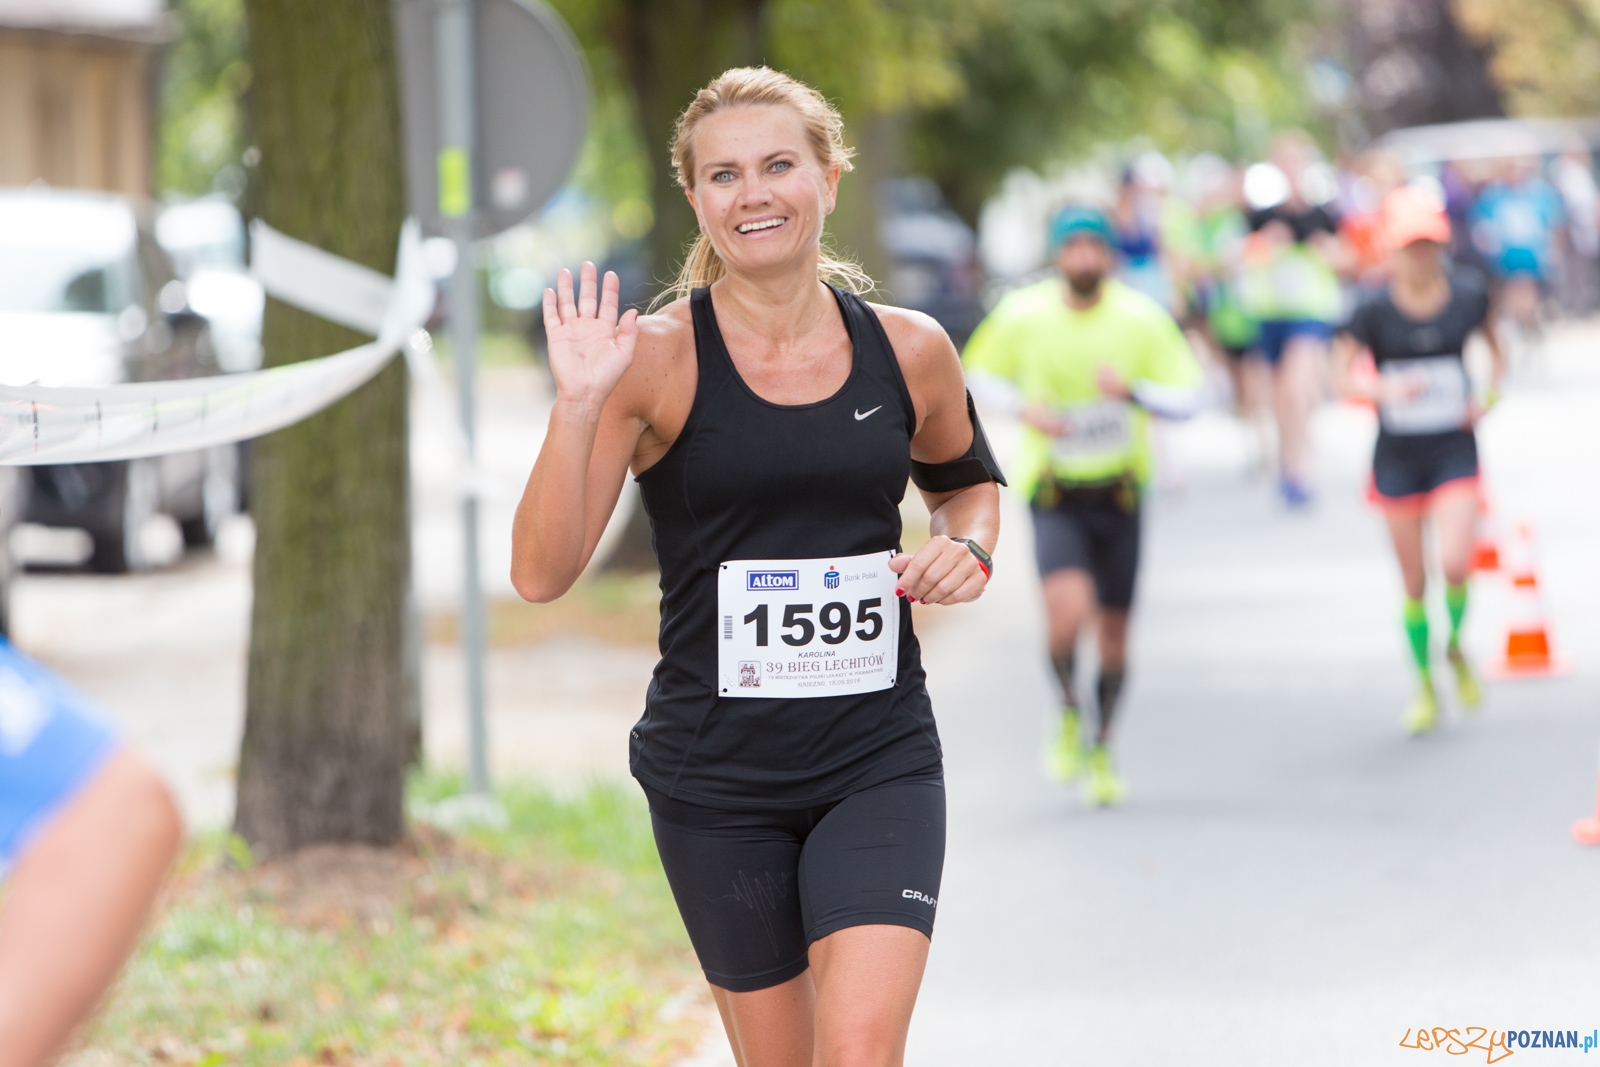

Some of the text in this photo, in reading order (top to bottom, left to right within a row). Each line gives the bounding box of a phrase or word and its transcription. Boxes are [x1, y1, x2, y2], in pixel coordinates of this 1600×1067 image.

[844, 573, 860, 582] Bank
[861, 570, 879, 580] Polski
[743, 597, 883, 647] 1595
[797, 650, 836, 659] KAROLINA
[766, 651, 886, 675] 39 BIEG LECHITÓW
[797, 677, 861, 688] GNIEZNO, 18.09.2016
